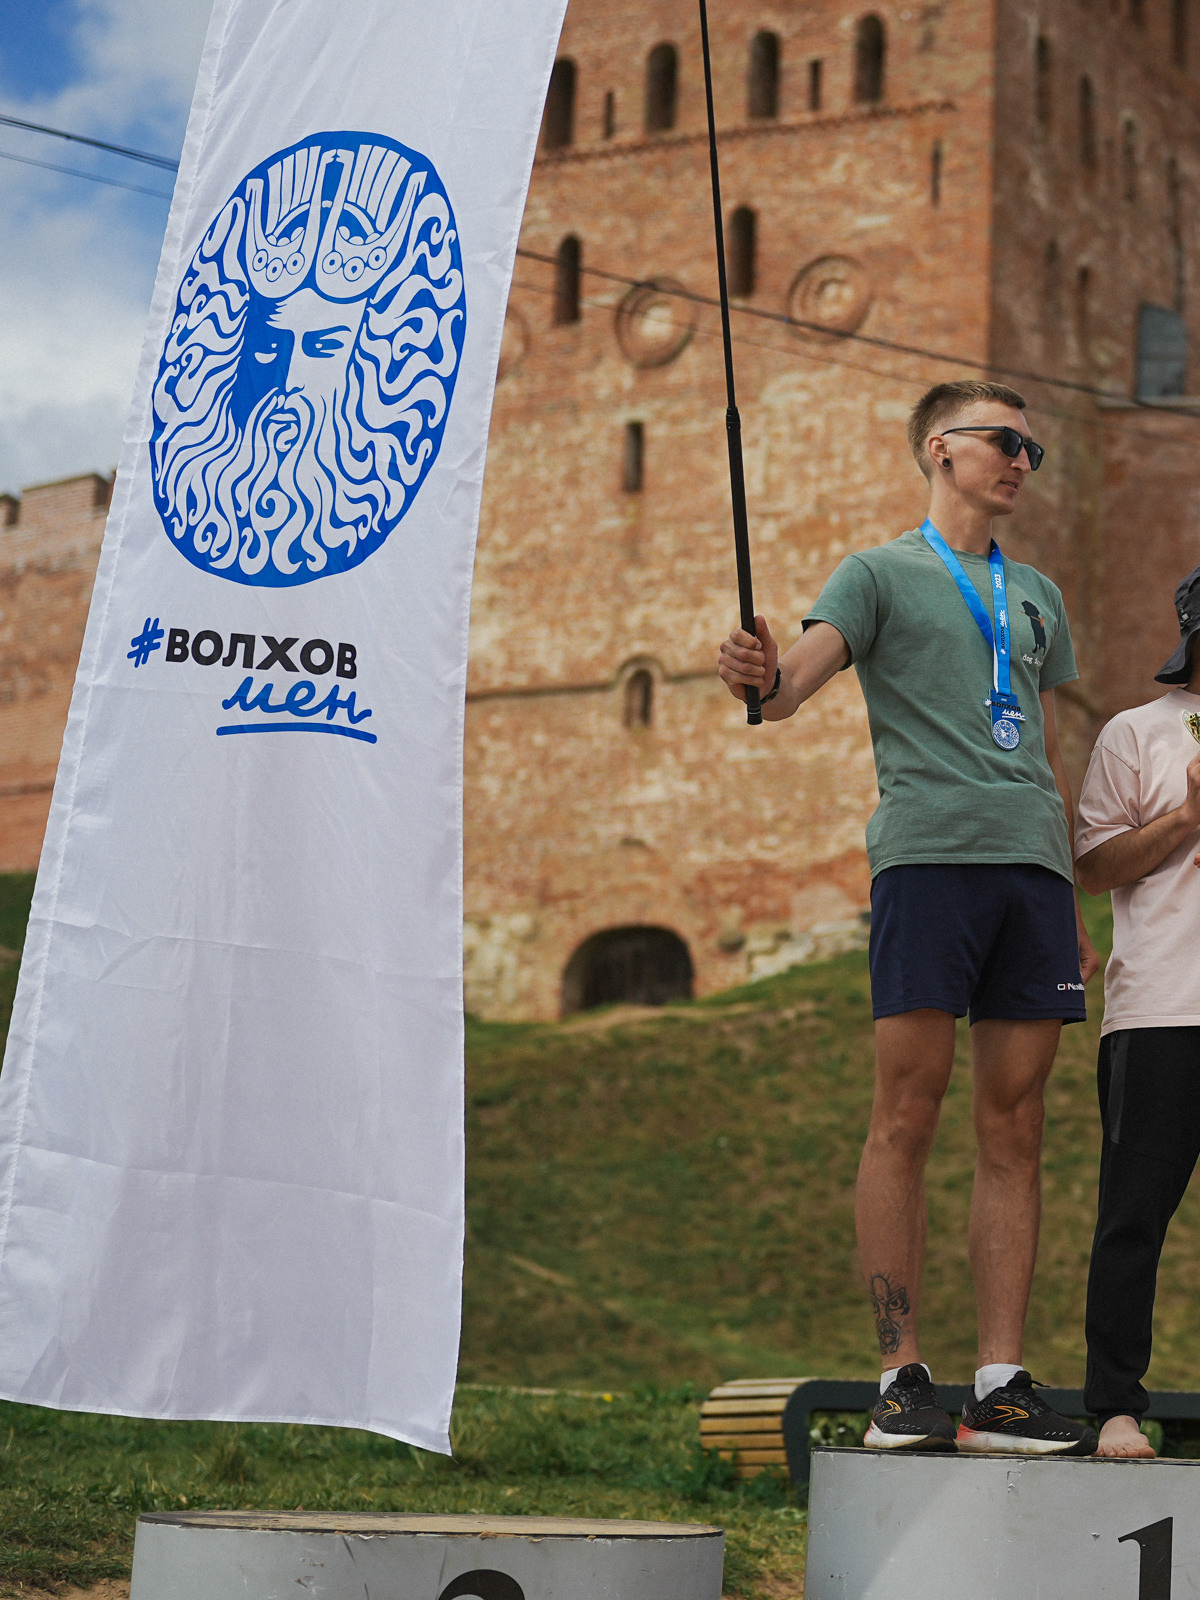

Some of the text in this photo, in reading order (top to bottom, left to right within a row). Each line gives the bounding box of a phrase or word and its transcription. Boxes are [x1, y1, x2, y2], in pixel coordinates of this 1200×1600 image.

[994, 574, 1003, 590] 2023
[127, 617, 357, 679] #ВОЛХОВ
[221, 676, 372, 725] мен
[1118, 1516, 1173, 1600] 1
